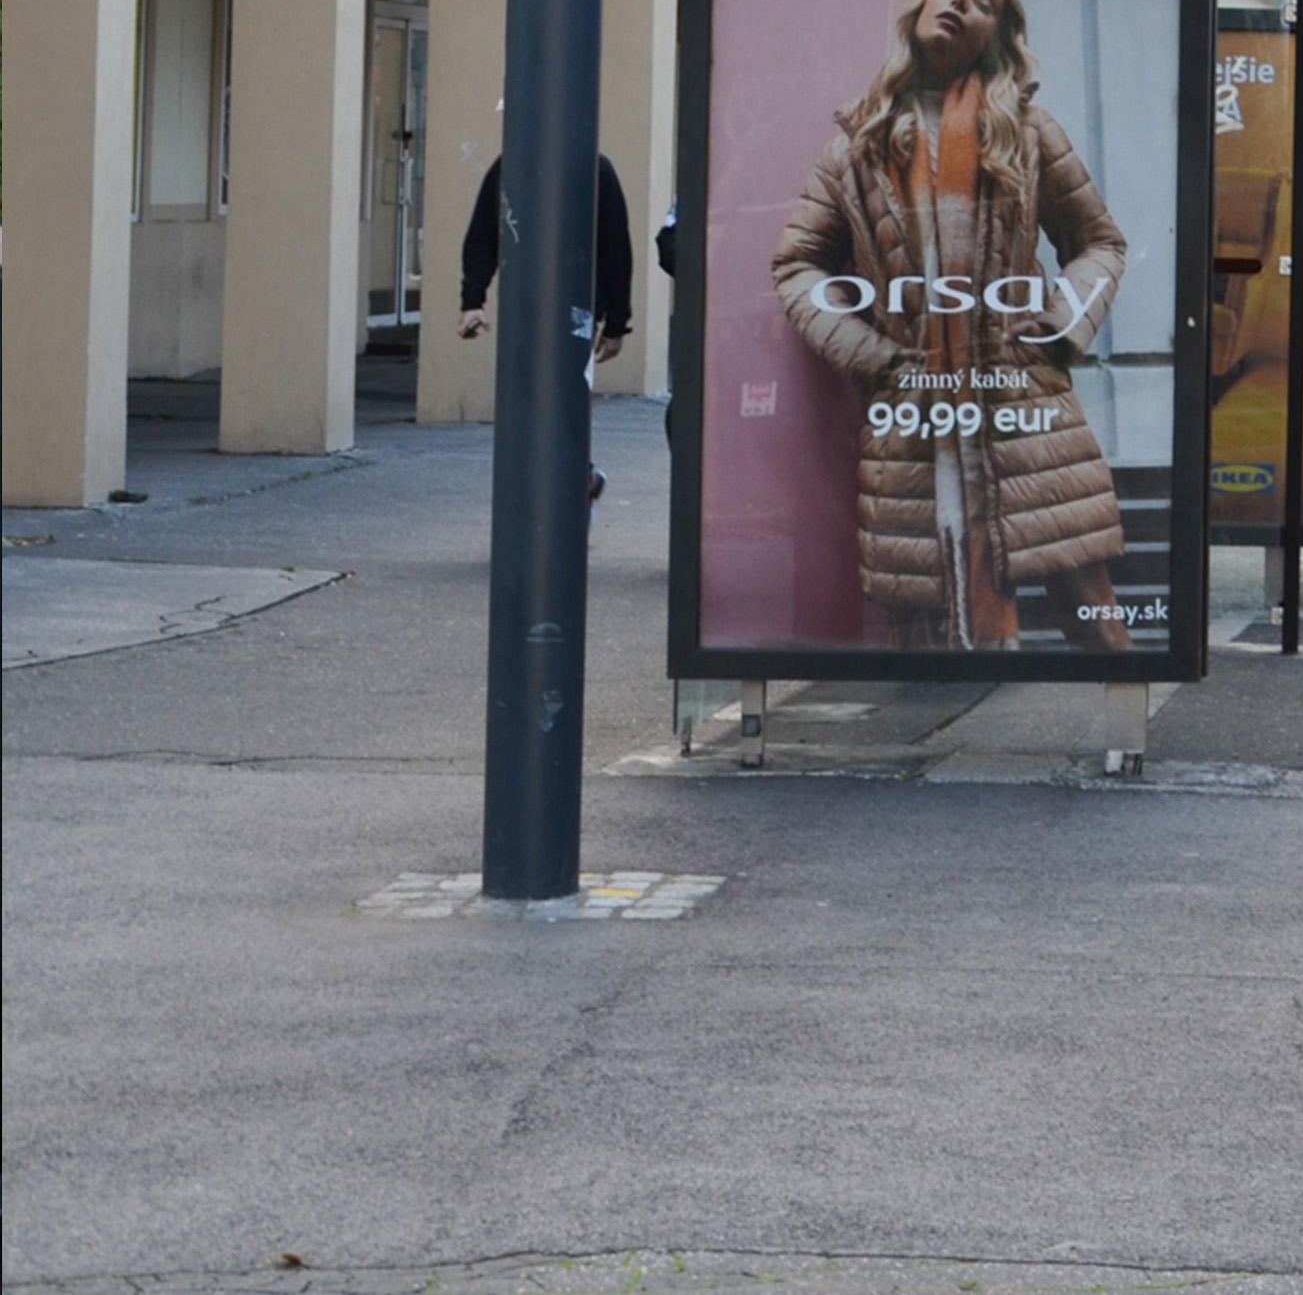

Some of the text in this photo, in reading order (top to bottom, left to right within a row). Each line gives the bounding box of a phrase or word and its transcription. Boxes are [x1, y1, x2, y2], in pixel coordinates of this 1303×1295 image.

[809, 274, 1110, 343] orsay
[898, 368, 1029, 393] zimný kabát
[868, 402, 1060, 440] 99,99 eur
[1211, 471, 1268, 485] IKEA
[1077, 597, 1169, 626] orsay.sk
